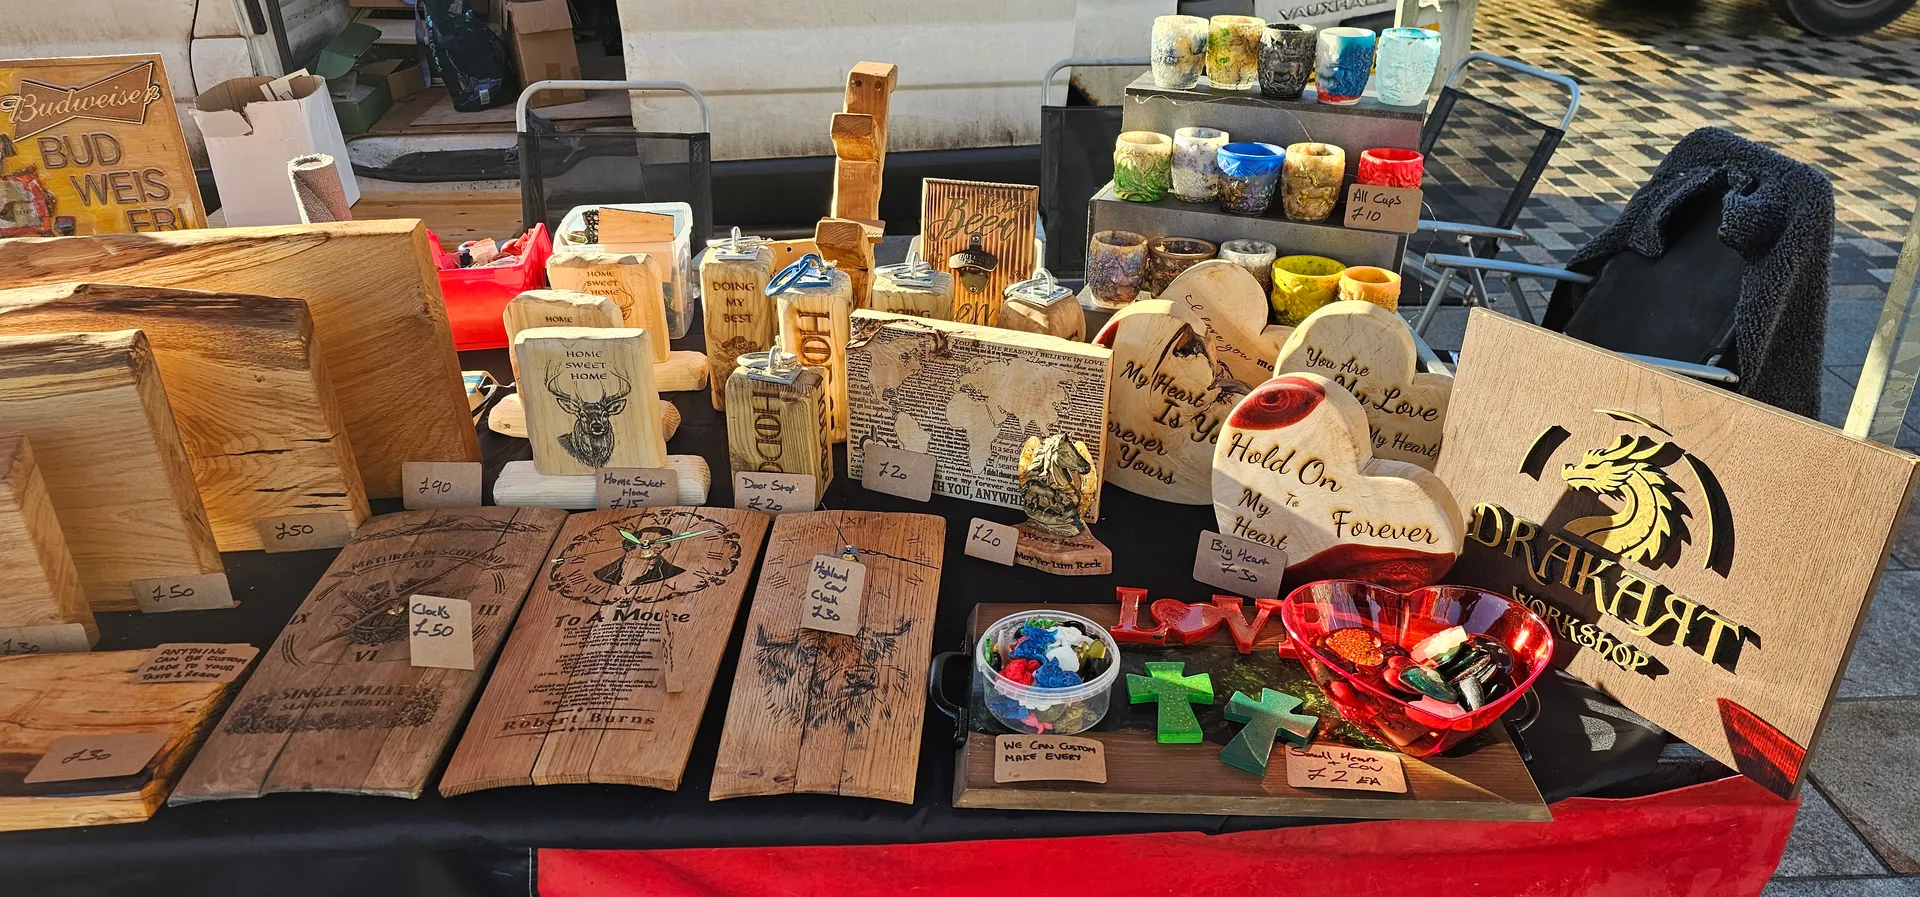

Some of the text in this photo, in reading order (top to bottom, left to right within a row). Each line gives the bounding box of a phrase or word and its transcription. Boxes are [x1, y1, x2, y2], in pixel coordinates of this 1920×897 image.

[1, 84, 162, 123] Budweiser
[36, 131, 122, 169] BUD
[70, 167, 170, 206] WEIS
[1353, 190, 1402, 207] All Cups
[927, 196, 1017, 242] Beer
[713, 281, 755, 292] DOING
[726, 299, 744, 308] MY
[724, 314, 754, 324] BEST
[565, 350, 602, 358] HOME
[1003, 347, 1033, 356] REASON
[1040, 353, 1072, 362] BELIEVE
[1216, 343, 1253, 361] you
[1256, 358, 1274, 372] mo
[1306, 347, 1370, 377] You Are
[1120, 361, 1206, 408] My Heart
[1373, 388, 1439, 422] Love
[1152, 399, 1184, 429] Is
[752, 391, 784, 473] HOD
[1108, 421, 1169, 456] rever
[1009, 455, 1019, 463] hea
[1117, 443, 1176, 485] Yours
[1227, 432, 1343, 493] Hold On
[604, 472, 631, 486] Home
[879, 462, 907, 480] £20
[419, 477, 452, 494] £90
[742, 477, 767, 489] Door
[960, 478, 972, 486] my
[975, 480, 1004, 491] forever
[622, 488, 649, 498] Home
[932, 480, 1026, 507] TH YOU, ANYWHE
[1285, 492, 1300, 508] To
[610, 498, 644, 509] £15
[1237, 488, 1272, 519] My
[651, 517, 673, 526] XII
[1332, 509, 1440, 545] Forever
[274, 522, 314, 540] £50
[972, 523, 1002, 547] £20
[1231, 516, 1289, 551] Heart
[423, 548, 438, 556] IN
[1051, 539, 1095, 550] Charm
[1210, 538, 1270, 566] Big Heart
[1015, 551, 1102, 570] May Yer Lum Reek
[813, 560, 850, 582] Highland
[152, 585, 195, 600] £50
[411, 603, 451, 619] Clocks
[555, 613, 581, 628] To
[585, 611, 605, 624] A
[811, 605, 841, 622] £30
[412, 618, 454, 637] £50
[1512, 585, 1650, 672] WORKSHOP
[154, 654, 248, 665] CAN BE CUSTOM
[160, 647, 228, 656] ANYTHING
[354, 649, 379, 663] VI
[147, 663, 180, 673] MADE
[205, 663, 235, 672] YOUR
[174, 670, 182, 678] &
[280, 685, 350, 700] SINGLE
[501, 712, 656, 733] Robert Burns
[1003, 740, 1096, 754] WE CAN CUSTOM
[1005, 752, 1082, 762] MAKE EVERY
